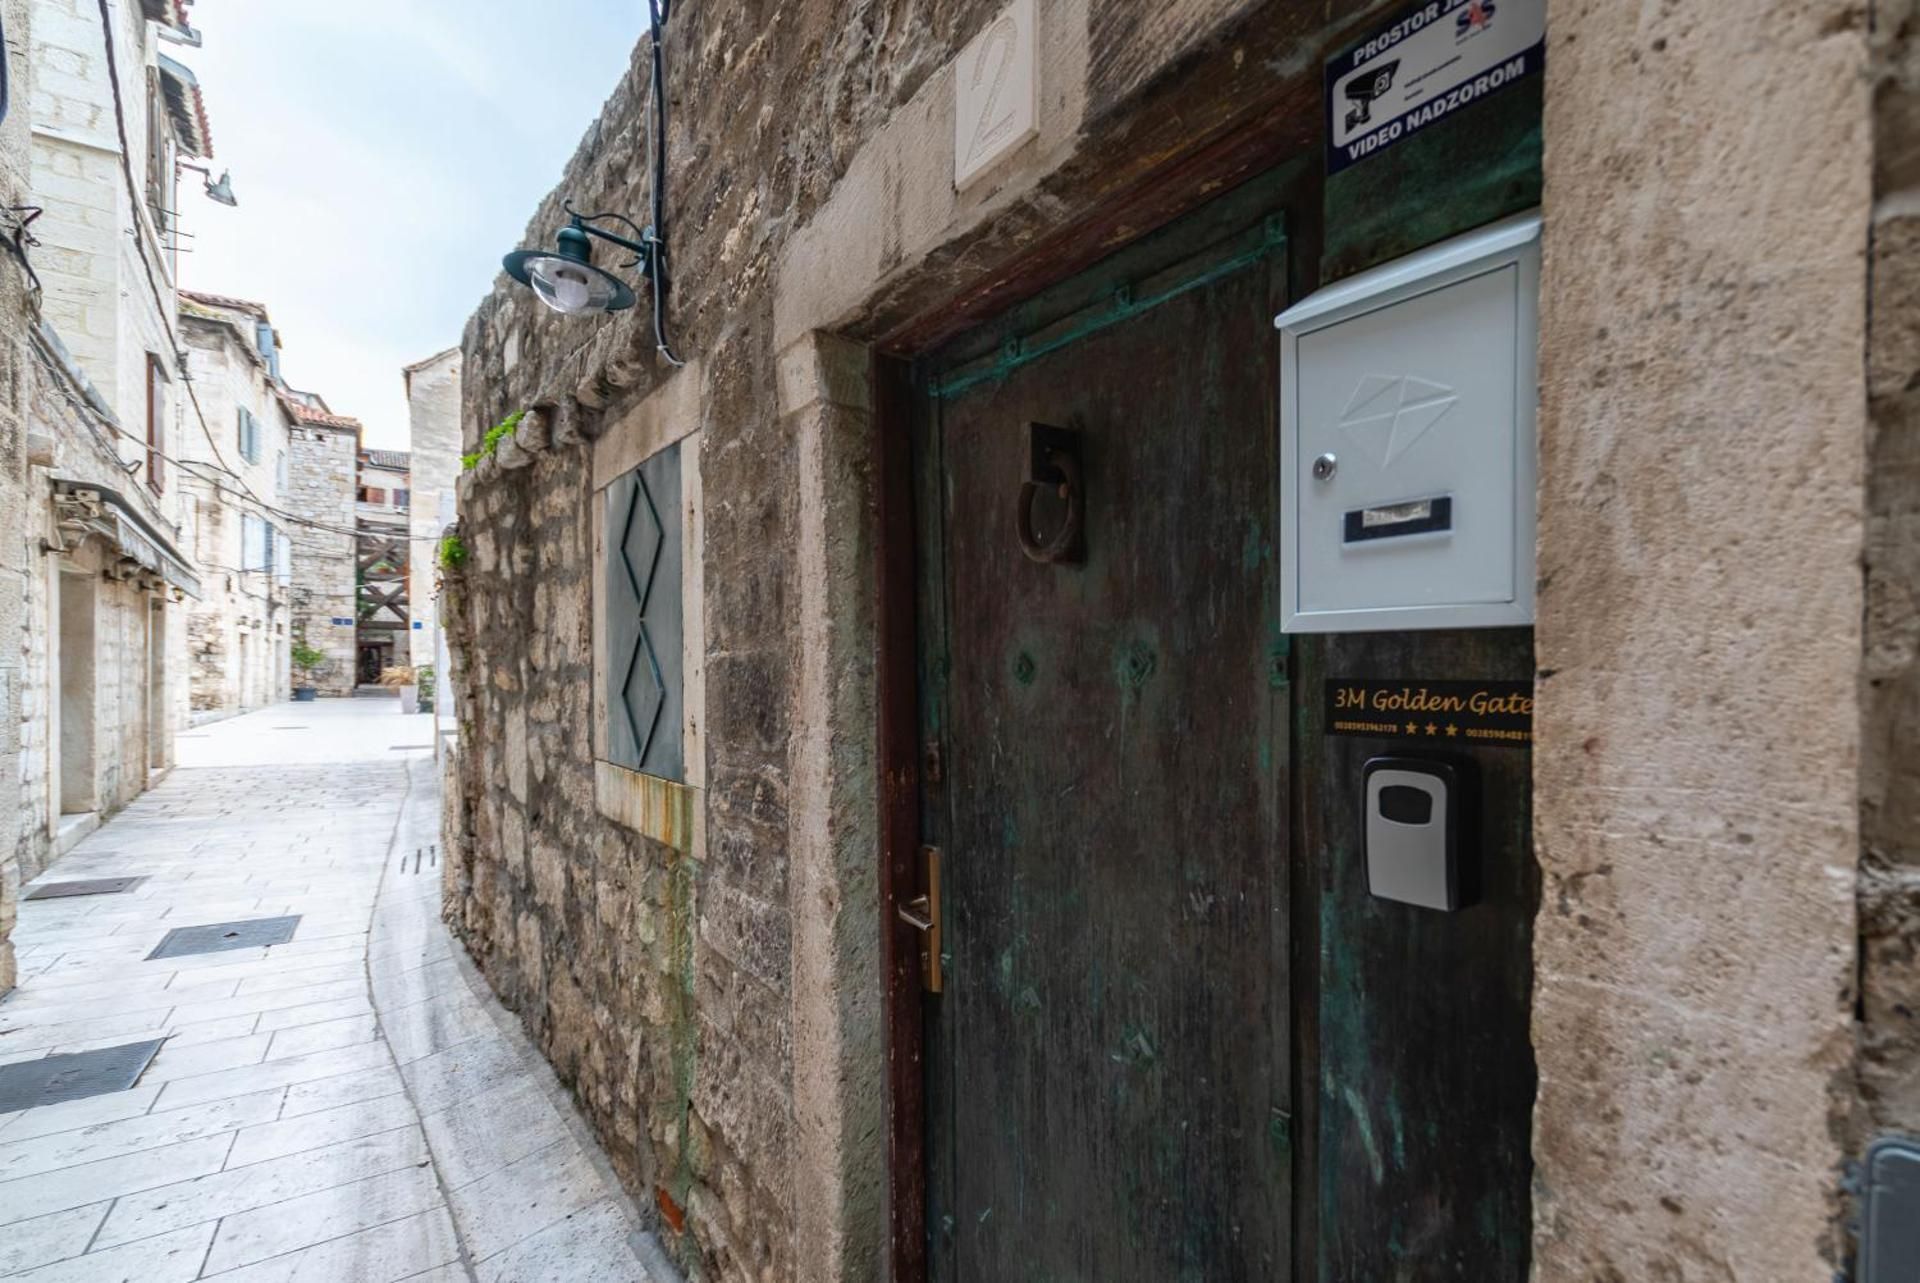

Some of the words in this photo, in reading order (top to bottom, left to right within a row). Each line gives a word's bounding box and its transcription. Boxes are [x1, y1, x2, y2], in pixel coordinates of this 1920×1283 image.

[1353, 6, 1439, 67] PROSTOR
[964, 16, 1018, 169] 2
[1349, 121, 1402, 160] VIDEO
[1406, 57, 1526, 132] NADZOROM
[1334, 687, 1365, 709] 3M
[1372, 687, 1467, 712] Golden
[1469, 691, 1534, 716] Gate
